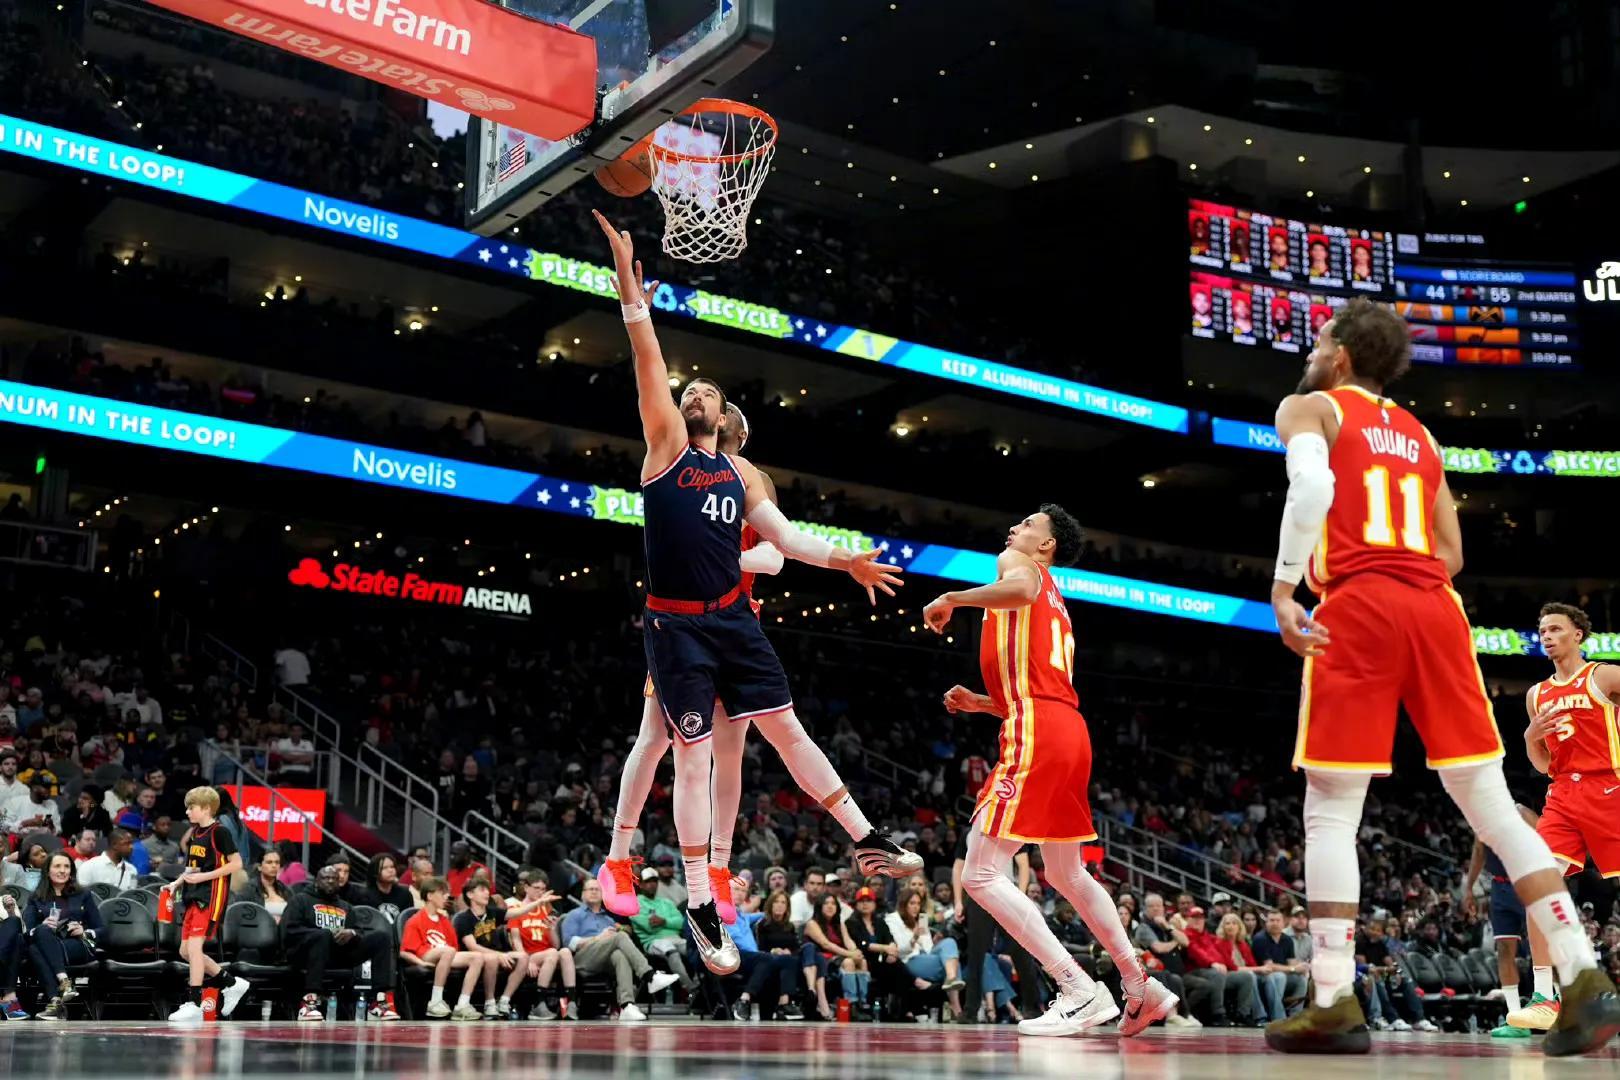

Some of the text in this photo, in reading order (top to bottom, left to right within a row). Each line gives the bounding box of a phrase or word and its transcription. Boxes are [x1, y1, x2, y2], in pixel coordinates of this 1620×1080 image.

[15, 128, 43, 151] IN
[53, 137, 101, 165] THE
[109, 151, 185, 186] LOOP!
[304, 197, 399, 240] Novelis
[1425, 284, 1446, 300] 44
[698, 298, 779, 329] RECYCLE
[941, 358, 1153, 420] KEEP ALUMINUM IN THE LOOP!
[68, 404, 96, 426] IN
[105, 411, 152, 436] THE
[160, 420, 237, 449] LOOP!
[1361, 427, 1420, 464] YOUNG
[352, 447, 457, 489] Novelis
[677, 467, 735, 492] Clippers
[701, 493, 736, 524] 40
[1363, 464, 1431, 556] 11
[331, 563, 532, 615] State Farm ARENA
[1129, 588, 1145, 604] IN
[1148, 591, 1172, 609] THE
[1175, 596, 1217, 616] LOOP!
[1556, 713, 1575, 742] 5
